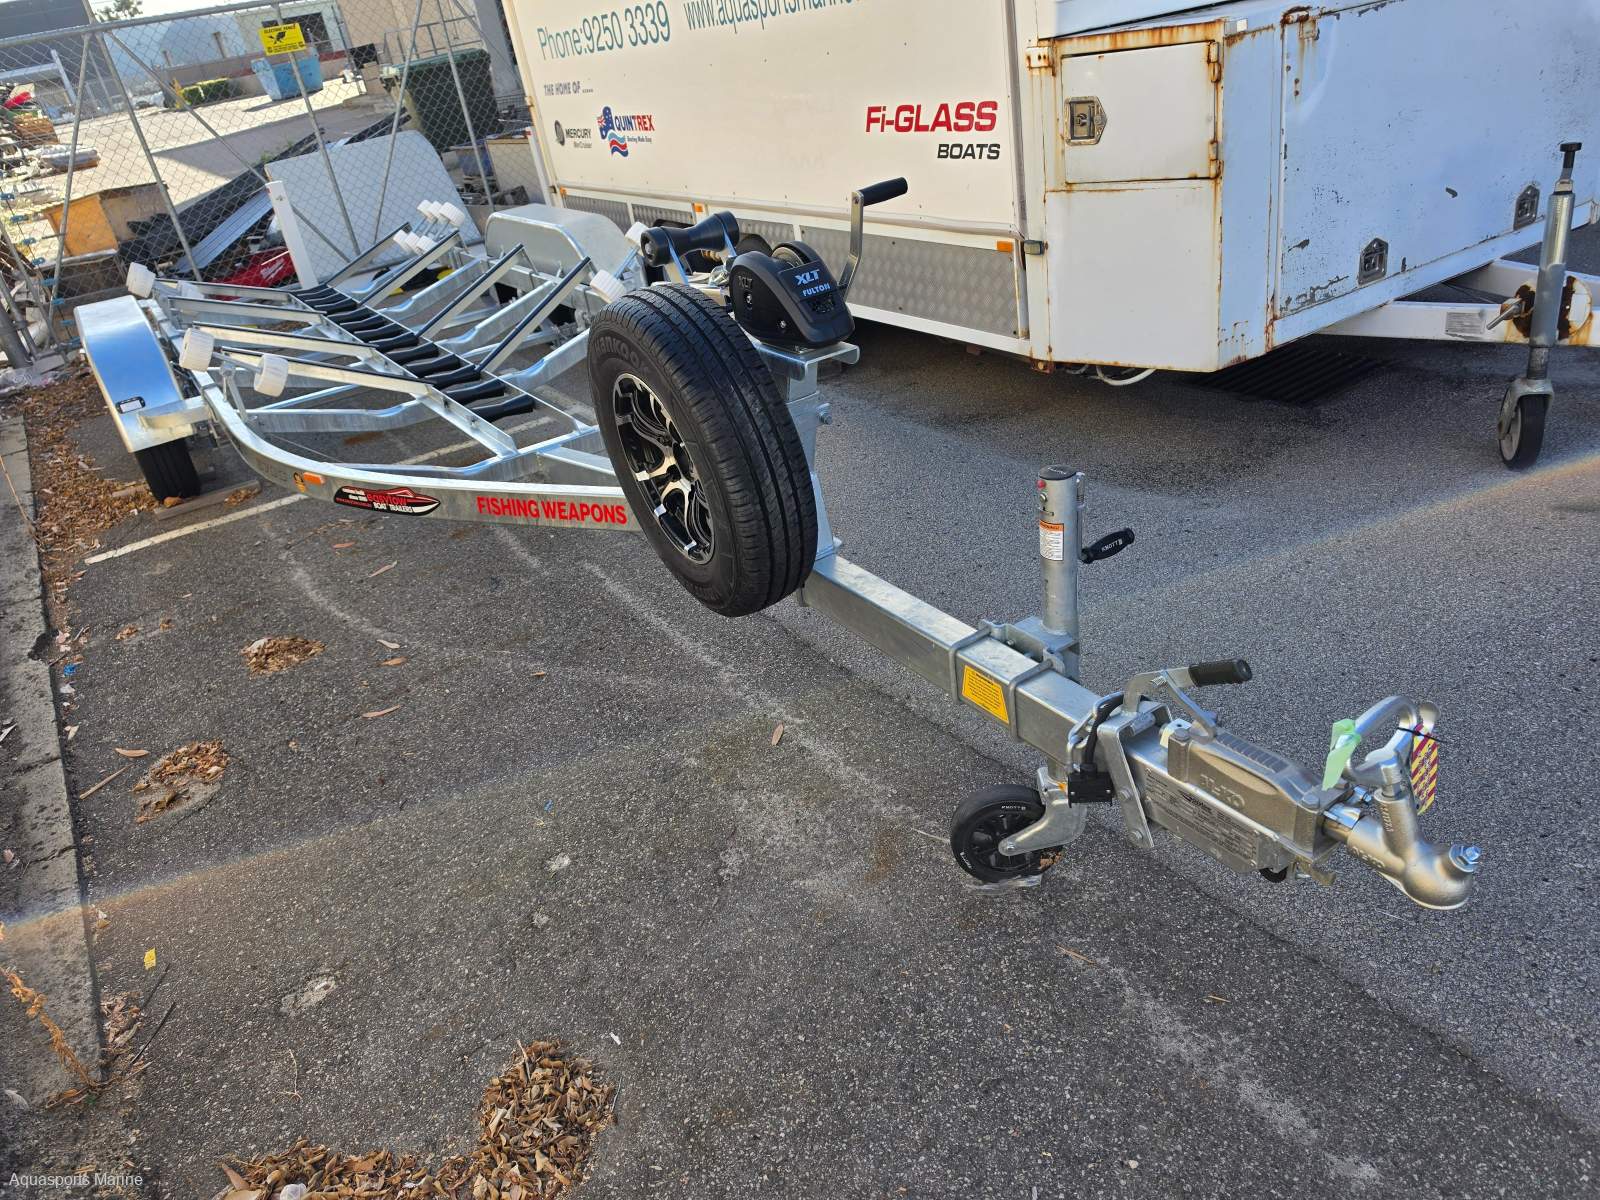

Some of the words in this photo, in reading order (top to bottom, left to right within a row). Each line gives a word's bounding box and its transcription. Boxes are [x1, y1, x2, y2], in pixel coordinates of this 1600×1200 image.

[624, 0, 671, 47] 3339
[543, 85, 555, 96] THE
[555, 82, 571, 95] HOME
[572, 81, 580, 94] OF
[614, 115, 655, 132] QUINTREX
[865, 101, 998, 132] Fi-GLASS
[565, 128, 591, 139] MERCURY
[937, 143, 1000, 160] BOATS
[794, 268, 820, 286] XLT
[802, 283, 831, 297] FULTON
[476, 496, 540, 518] FISHING
[540, 500, 627, 525] WEAPONS
